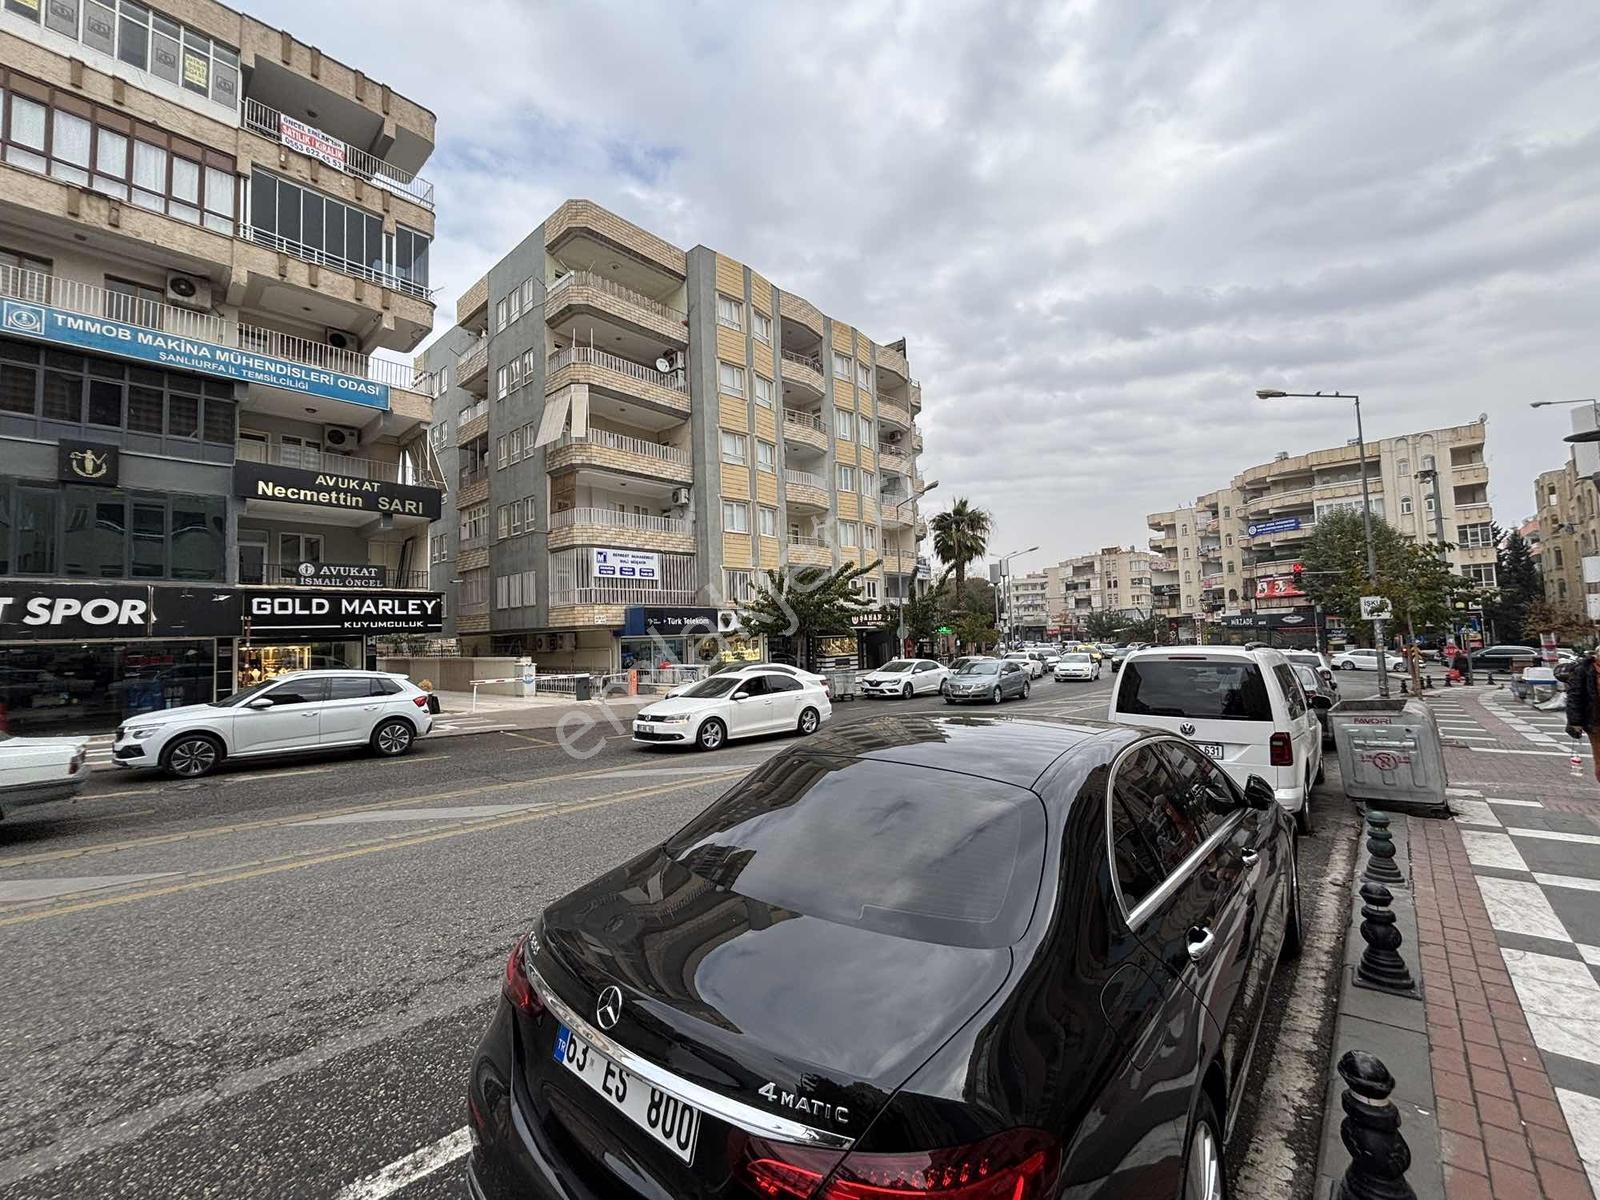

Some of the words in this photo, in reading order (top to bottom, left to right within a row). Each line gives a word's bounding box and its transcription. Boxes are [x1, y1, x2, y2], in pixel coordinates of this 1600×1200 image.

[281, 124, 311, 146] SATILIK
[284, 136, 304, 152] 0553
[306, 146, 320, 157] 622
[53, 313, 132, 341] TMMOB
[137, 330, 211, 358] MAKİNA
[215, 350, 334, 385] MÜHENDİSLERİ
[338, 378, 380, 396] ODASI
[159, 351, 226, 373] ŞANLIURFA
[229, 363, 239, 376] İL
[315, 474, 381, 493] AVUKAT
[257, 480, 364, 508] Necmettin
[377, 496, 423, 515] SARI
[300, 575, 344, 586] İSMAİL
[345, 576, 384, 588] ÖNCEL
[319, 566, 379, 577] AVUKAT
[22, 597, 147, 626] SPOR
[251, 597, 331, 615] GOLD
[341, 598, 438, 615] MARLEY
[344, 620, 425, 629] KUYUMCULUK
[667, 616, 682, 625] Türk
[683, 616, 710, 625] Telekom
[1204, 745, 1220, 757] 631
[558, 1038, 567, 1053] TR
[602, 1061, 631, 1104] ES
[647, 1087, 694, 1151] 800
[758, 1081, 850, 1124] 4MATIC
